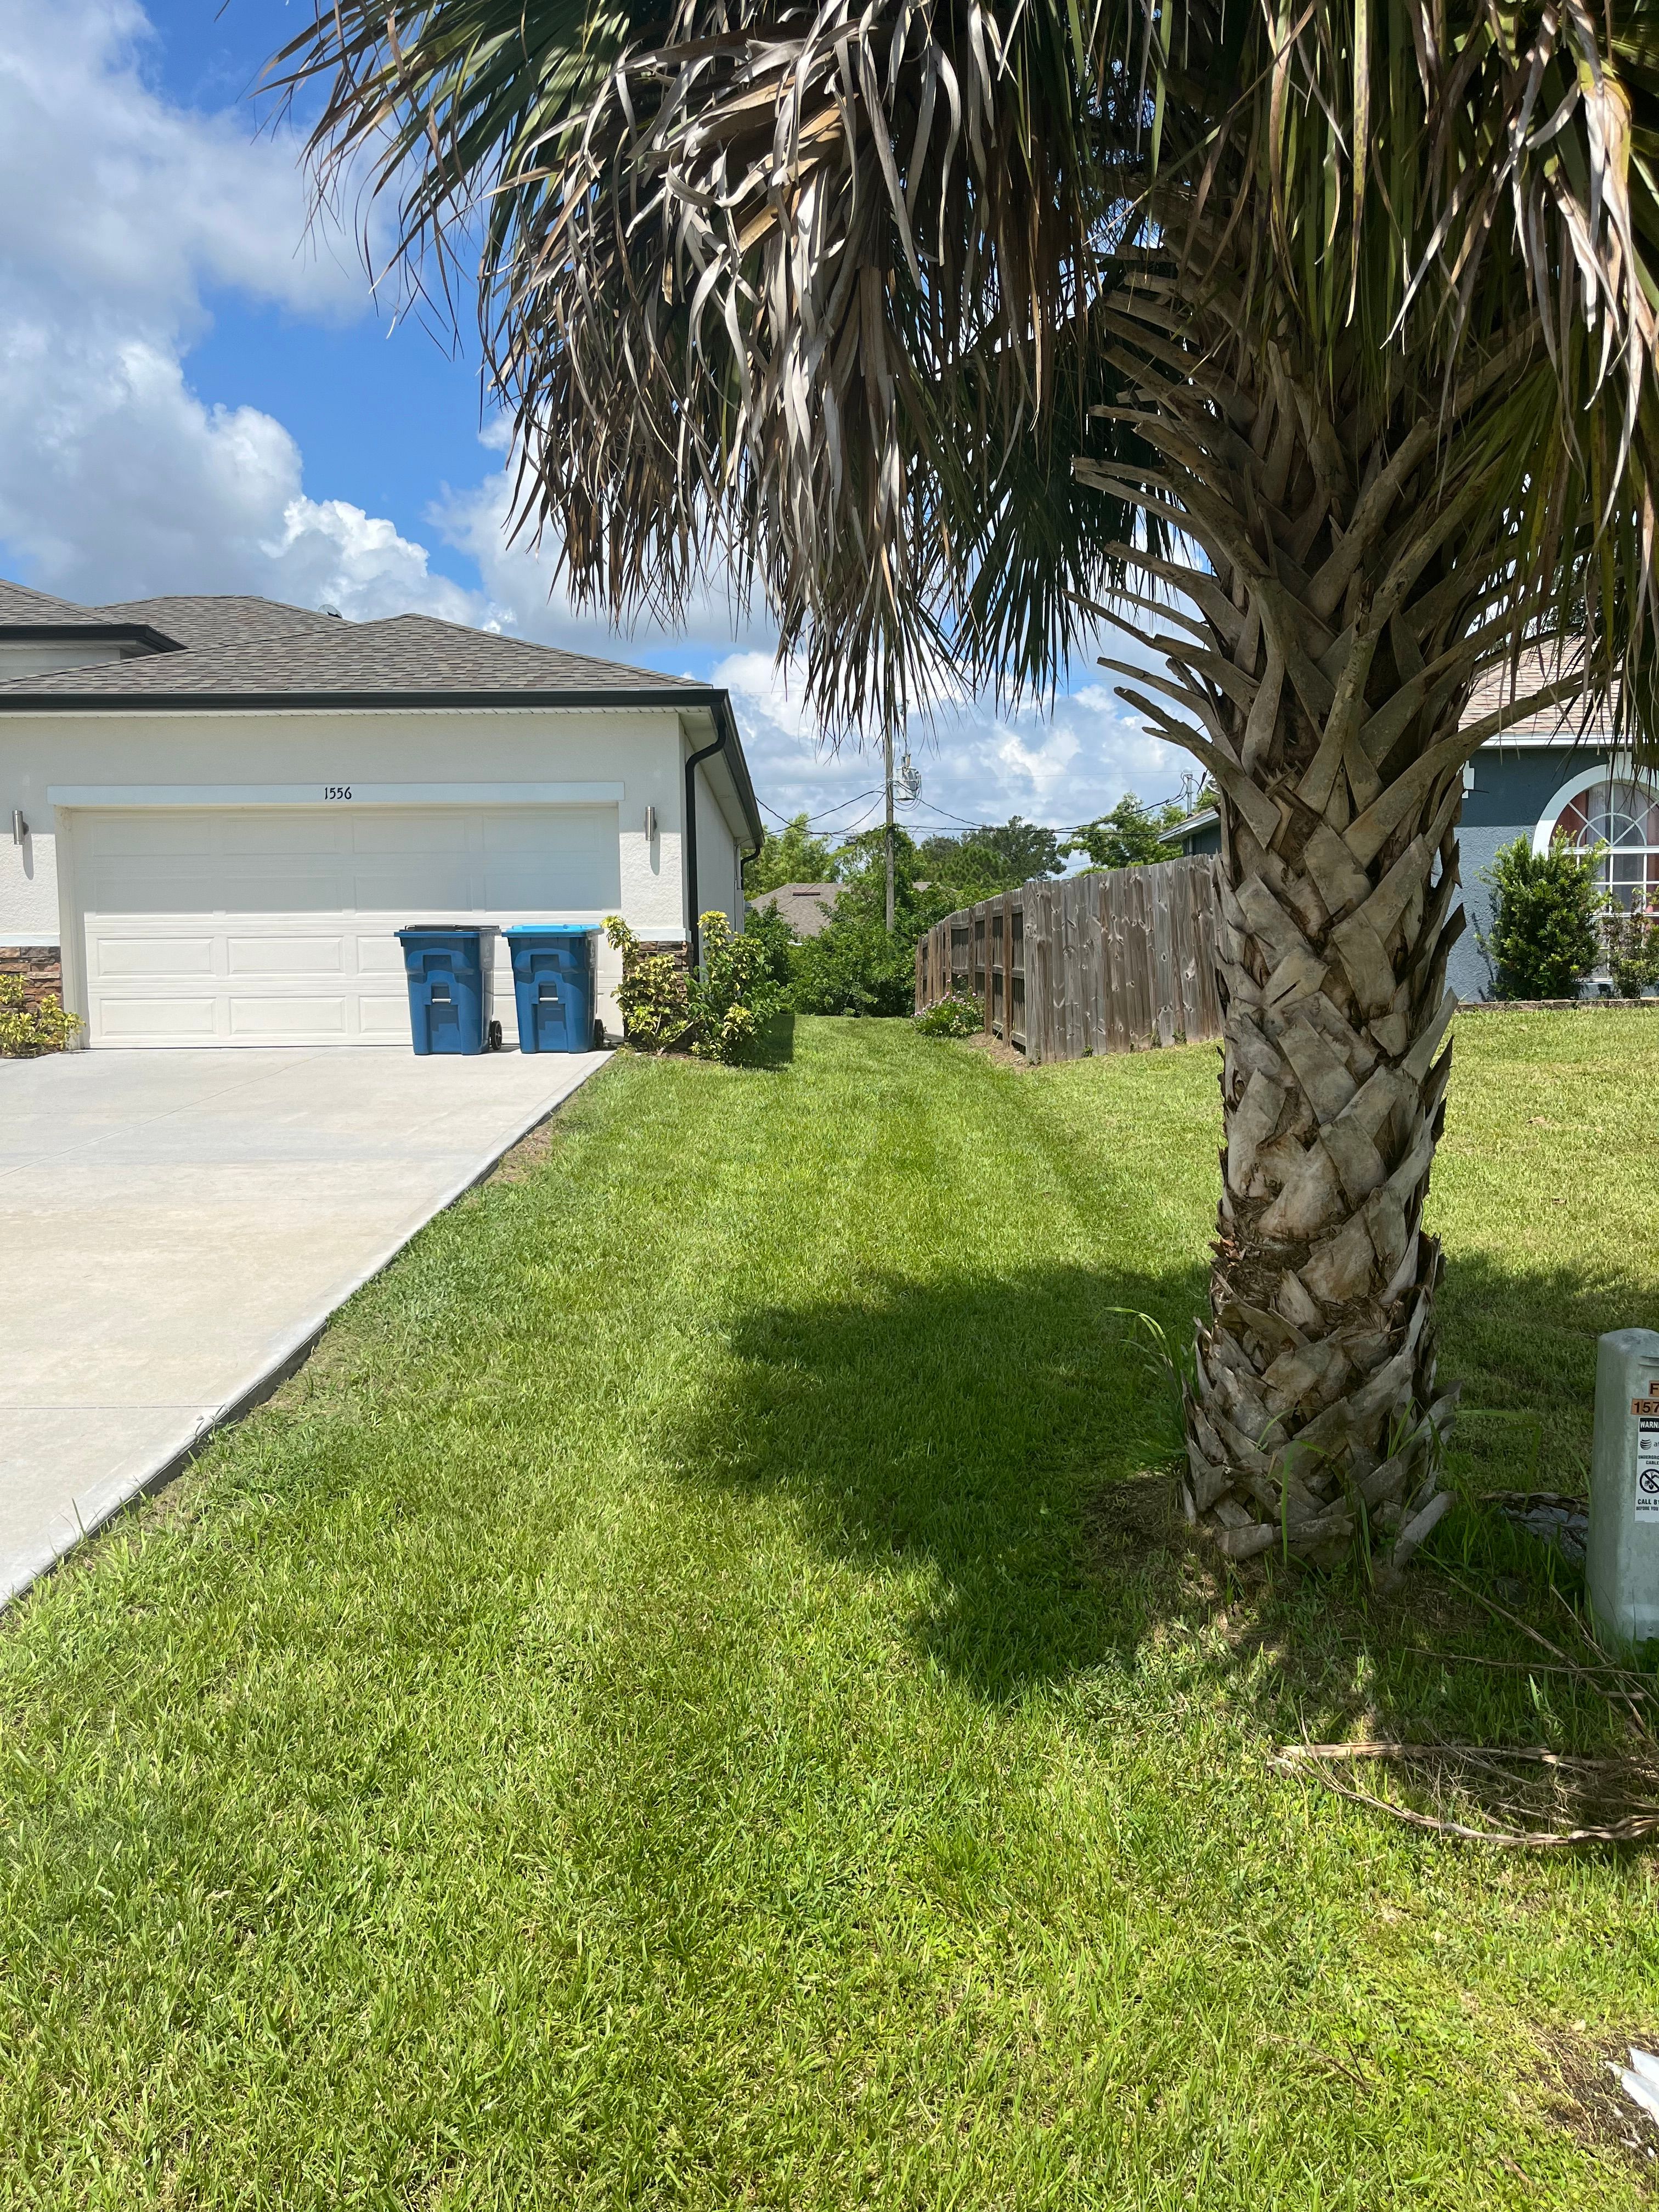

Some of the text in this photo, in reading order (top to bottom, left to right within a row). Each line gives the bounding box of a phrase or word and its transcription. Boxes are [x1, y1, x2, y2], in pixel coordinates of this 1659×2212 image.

[325, 786, 352, 800] 1556
[1650, 1383, 1659, 1395] F
[1634, 1401, 1659, 1413] 157
